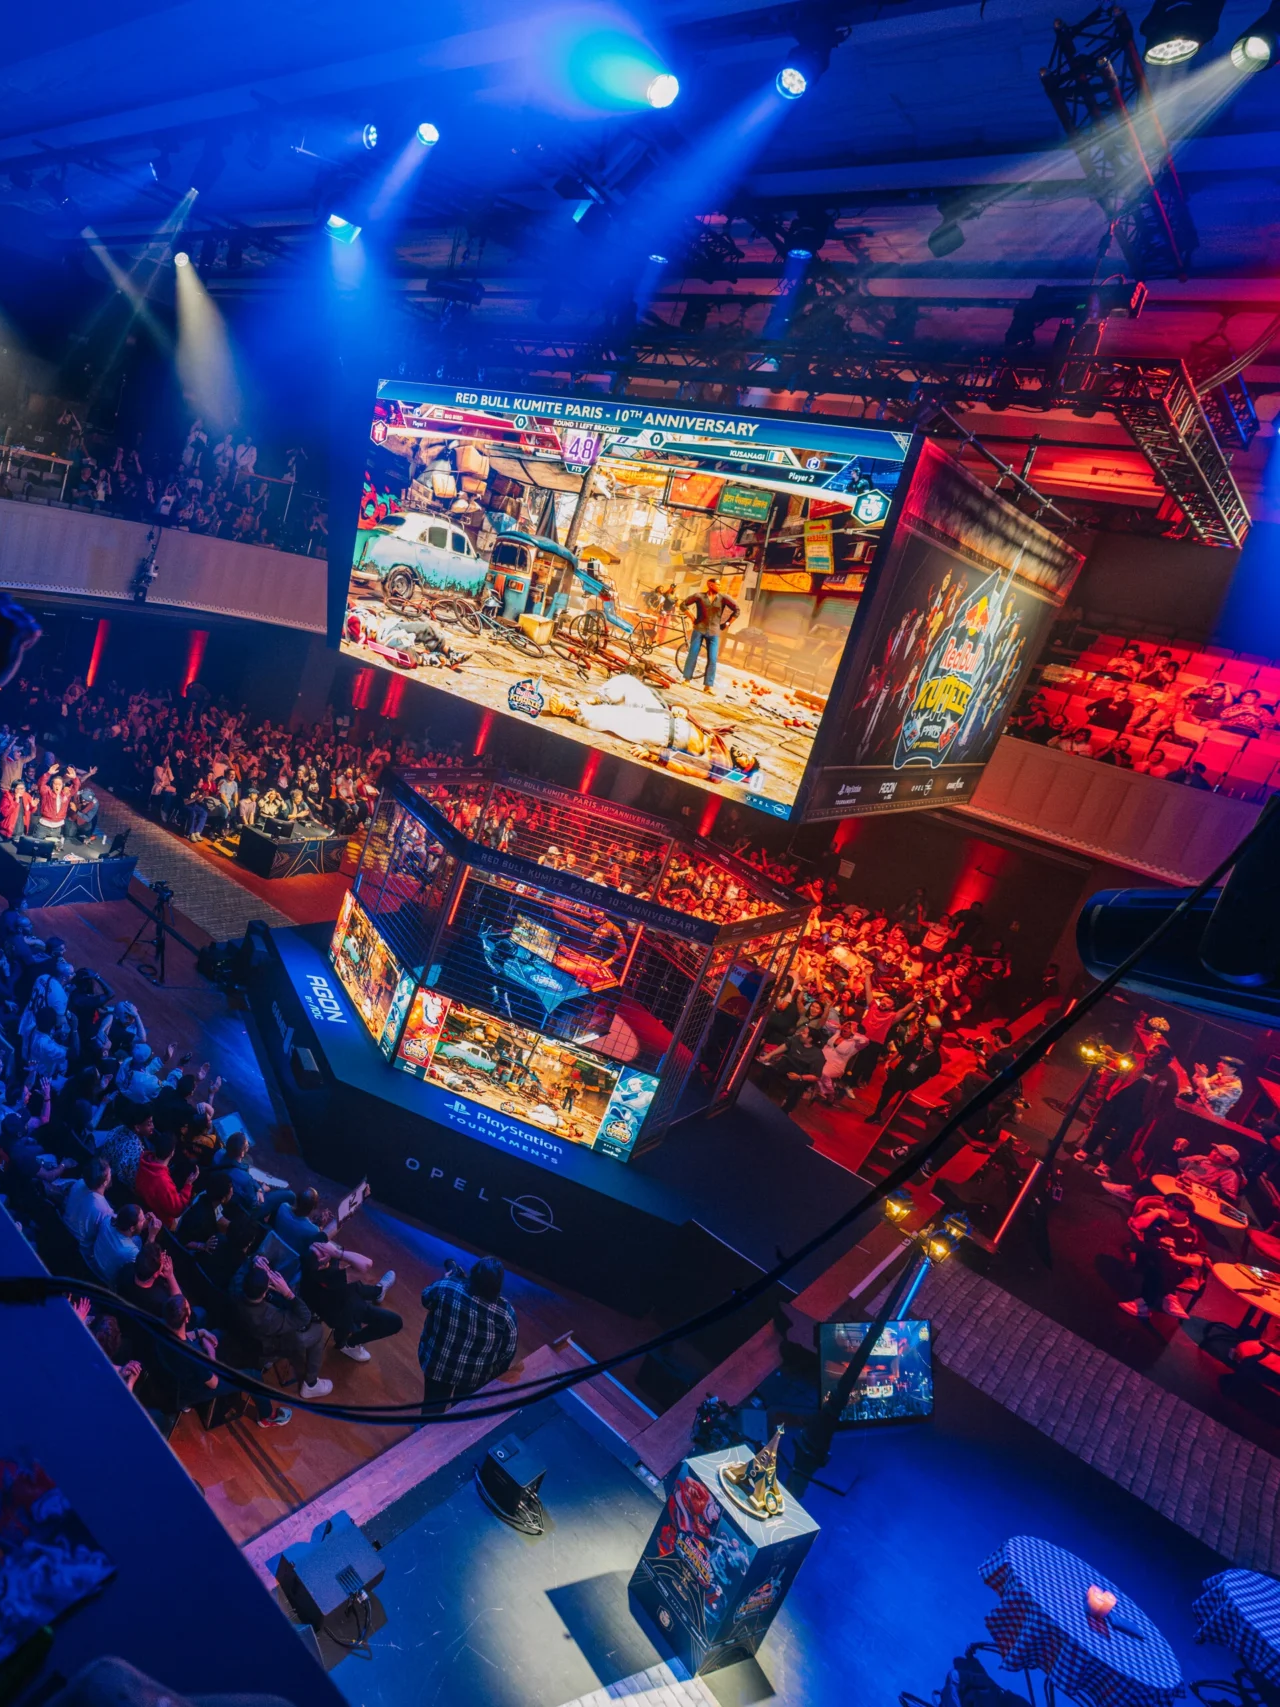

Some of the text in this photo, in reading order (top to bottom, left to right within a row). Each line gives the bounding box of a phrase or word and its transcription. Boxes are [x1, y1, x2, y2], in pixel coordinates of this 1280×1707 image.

[455, 392, 478, 405] RED
[480, 395, 510, 409] BULL
[513, 398, 563, 415] KUMITE
[564, 404, 603, 419] PARIS
[615, 409, 643, 422] 10TH
[642, 412, 759, 437] ANNIVERSARY
[553, 419, 575, 427] ROUND
[594, 424, 621, 433] BRACKET
[568, 437, 594, 460] 48
[729, 449, 766, 460] KUSANAGI
[788, 472, 808, 482] Player
[508, 776, 521, 786] RED
[524, 781, 540, 791] BULL
[542, 787, 569, 800] KUMITE
[572, 796, 597, 809] PARIS
[614, 808, 665, 830] ANNIVERSARY
[746, 796, 769, 808] OPEL
[480, 853, 500, 865] RED
[502, 859, 524, 874] BULL
[527, 867, 564, 888] KUMITE
[571, 882, 604, 899] PARIS
[627, 901, 699, 932] ANNIVERSARY
[306, 974, 347, 1023] AGON
[448, 1113, 558, 1164] TOURNAMENTS
[476, 1112, 563, 1154] PlayStation
[405, 1157, 489, 1202] OPEL
